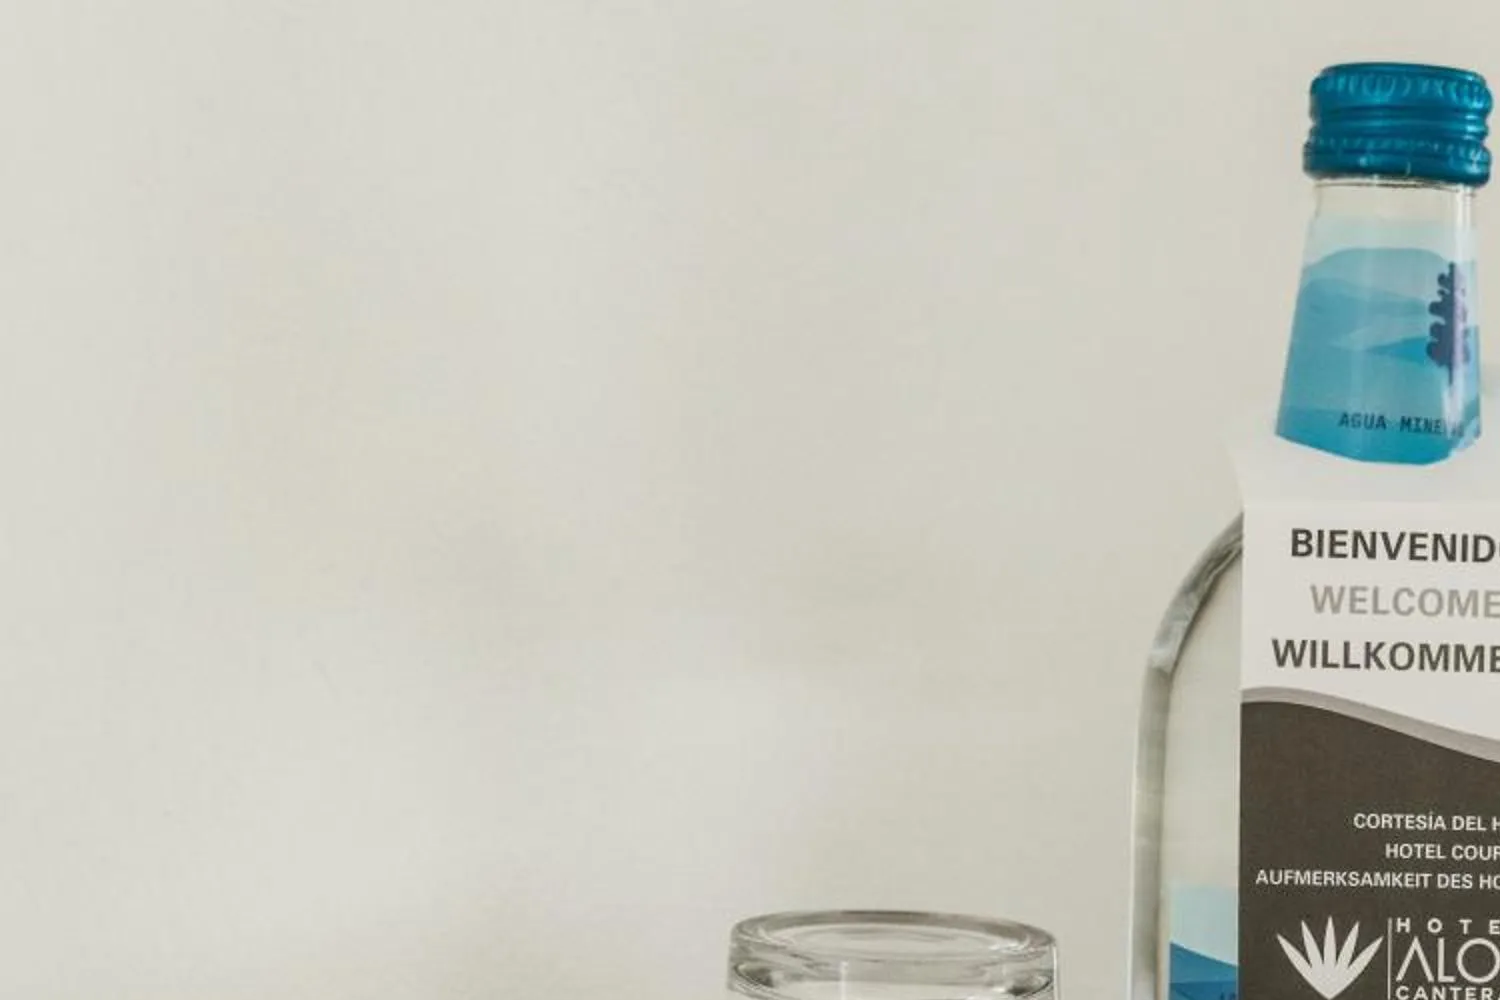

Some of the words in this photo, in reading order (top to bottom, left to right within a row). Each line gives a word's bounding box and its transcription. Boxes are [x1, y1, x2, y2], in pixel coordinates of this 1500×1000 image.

[1338, 412, 1387, 430] AGUA
[1353, 811, 1446, 831] CORTESÍA
[1452, 815, 1487, 832] DEL
[1385, 843, 1446, 860] HOTEL
[1255, 869, 1432, 889] AUFMERKSAMKEIT
[1437, 873, 1473, 890] DES
